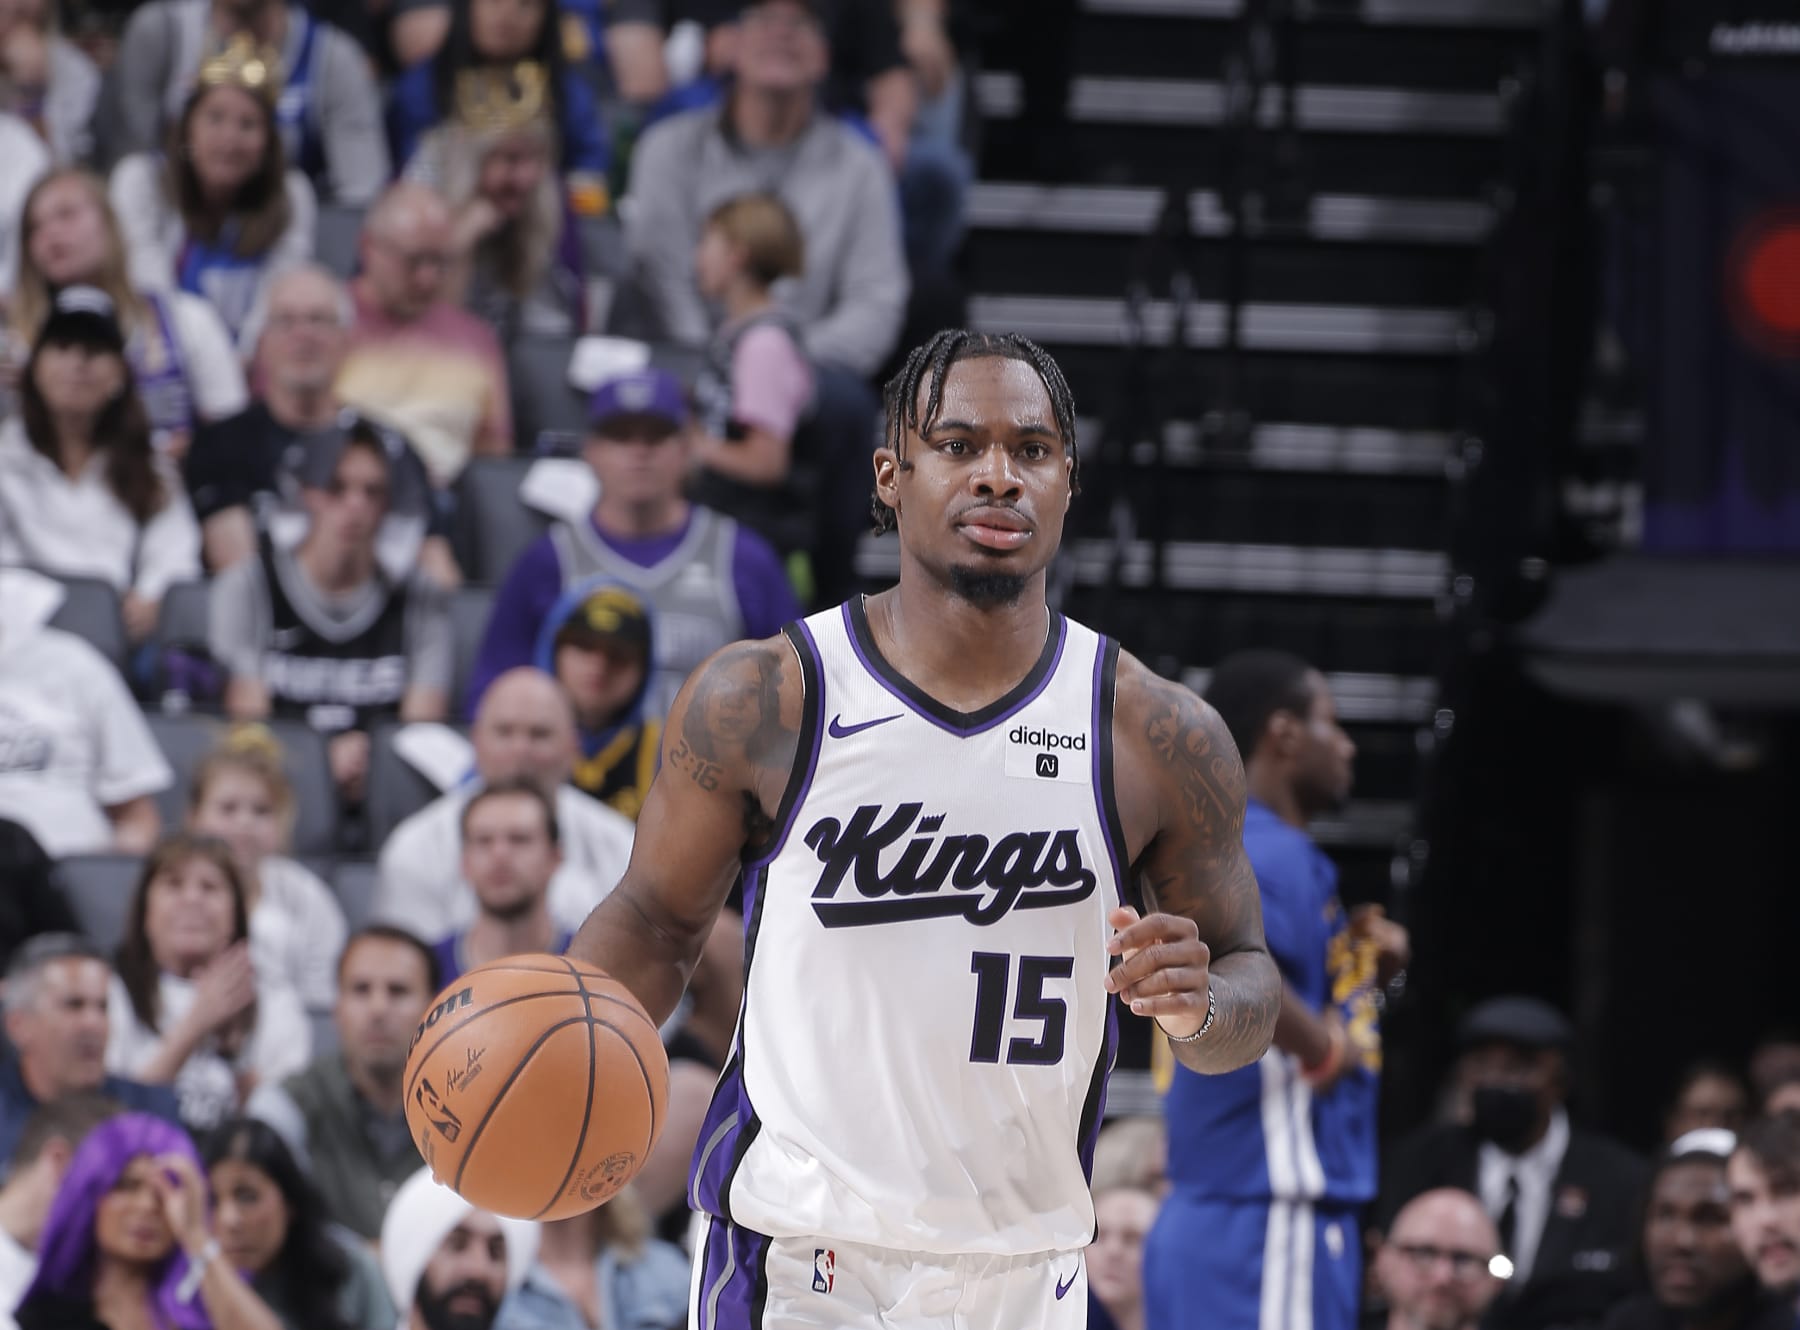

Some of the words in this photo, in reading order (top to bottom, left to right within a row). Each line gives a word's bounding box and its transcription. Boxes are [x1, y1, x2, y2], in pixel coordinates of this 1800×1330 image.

[669, 738, 723, 792] 2:16
[1009, 725, 1086, 751] dialpad
[803, 802, 1096, 928] Kings
[969, 951, 1074, 1066] 15
